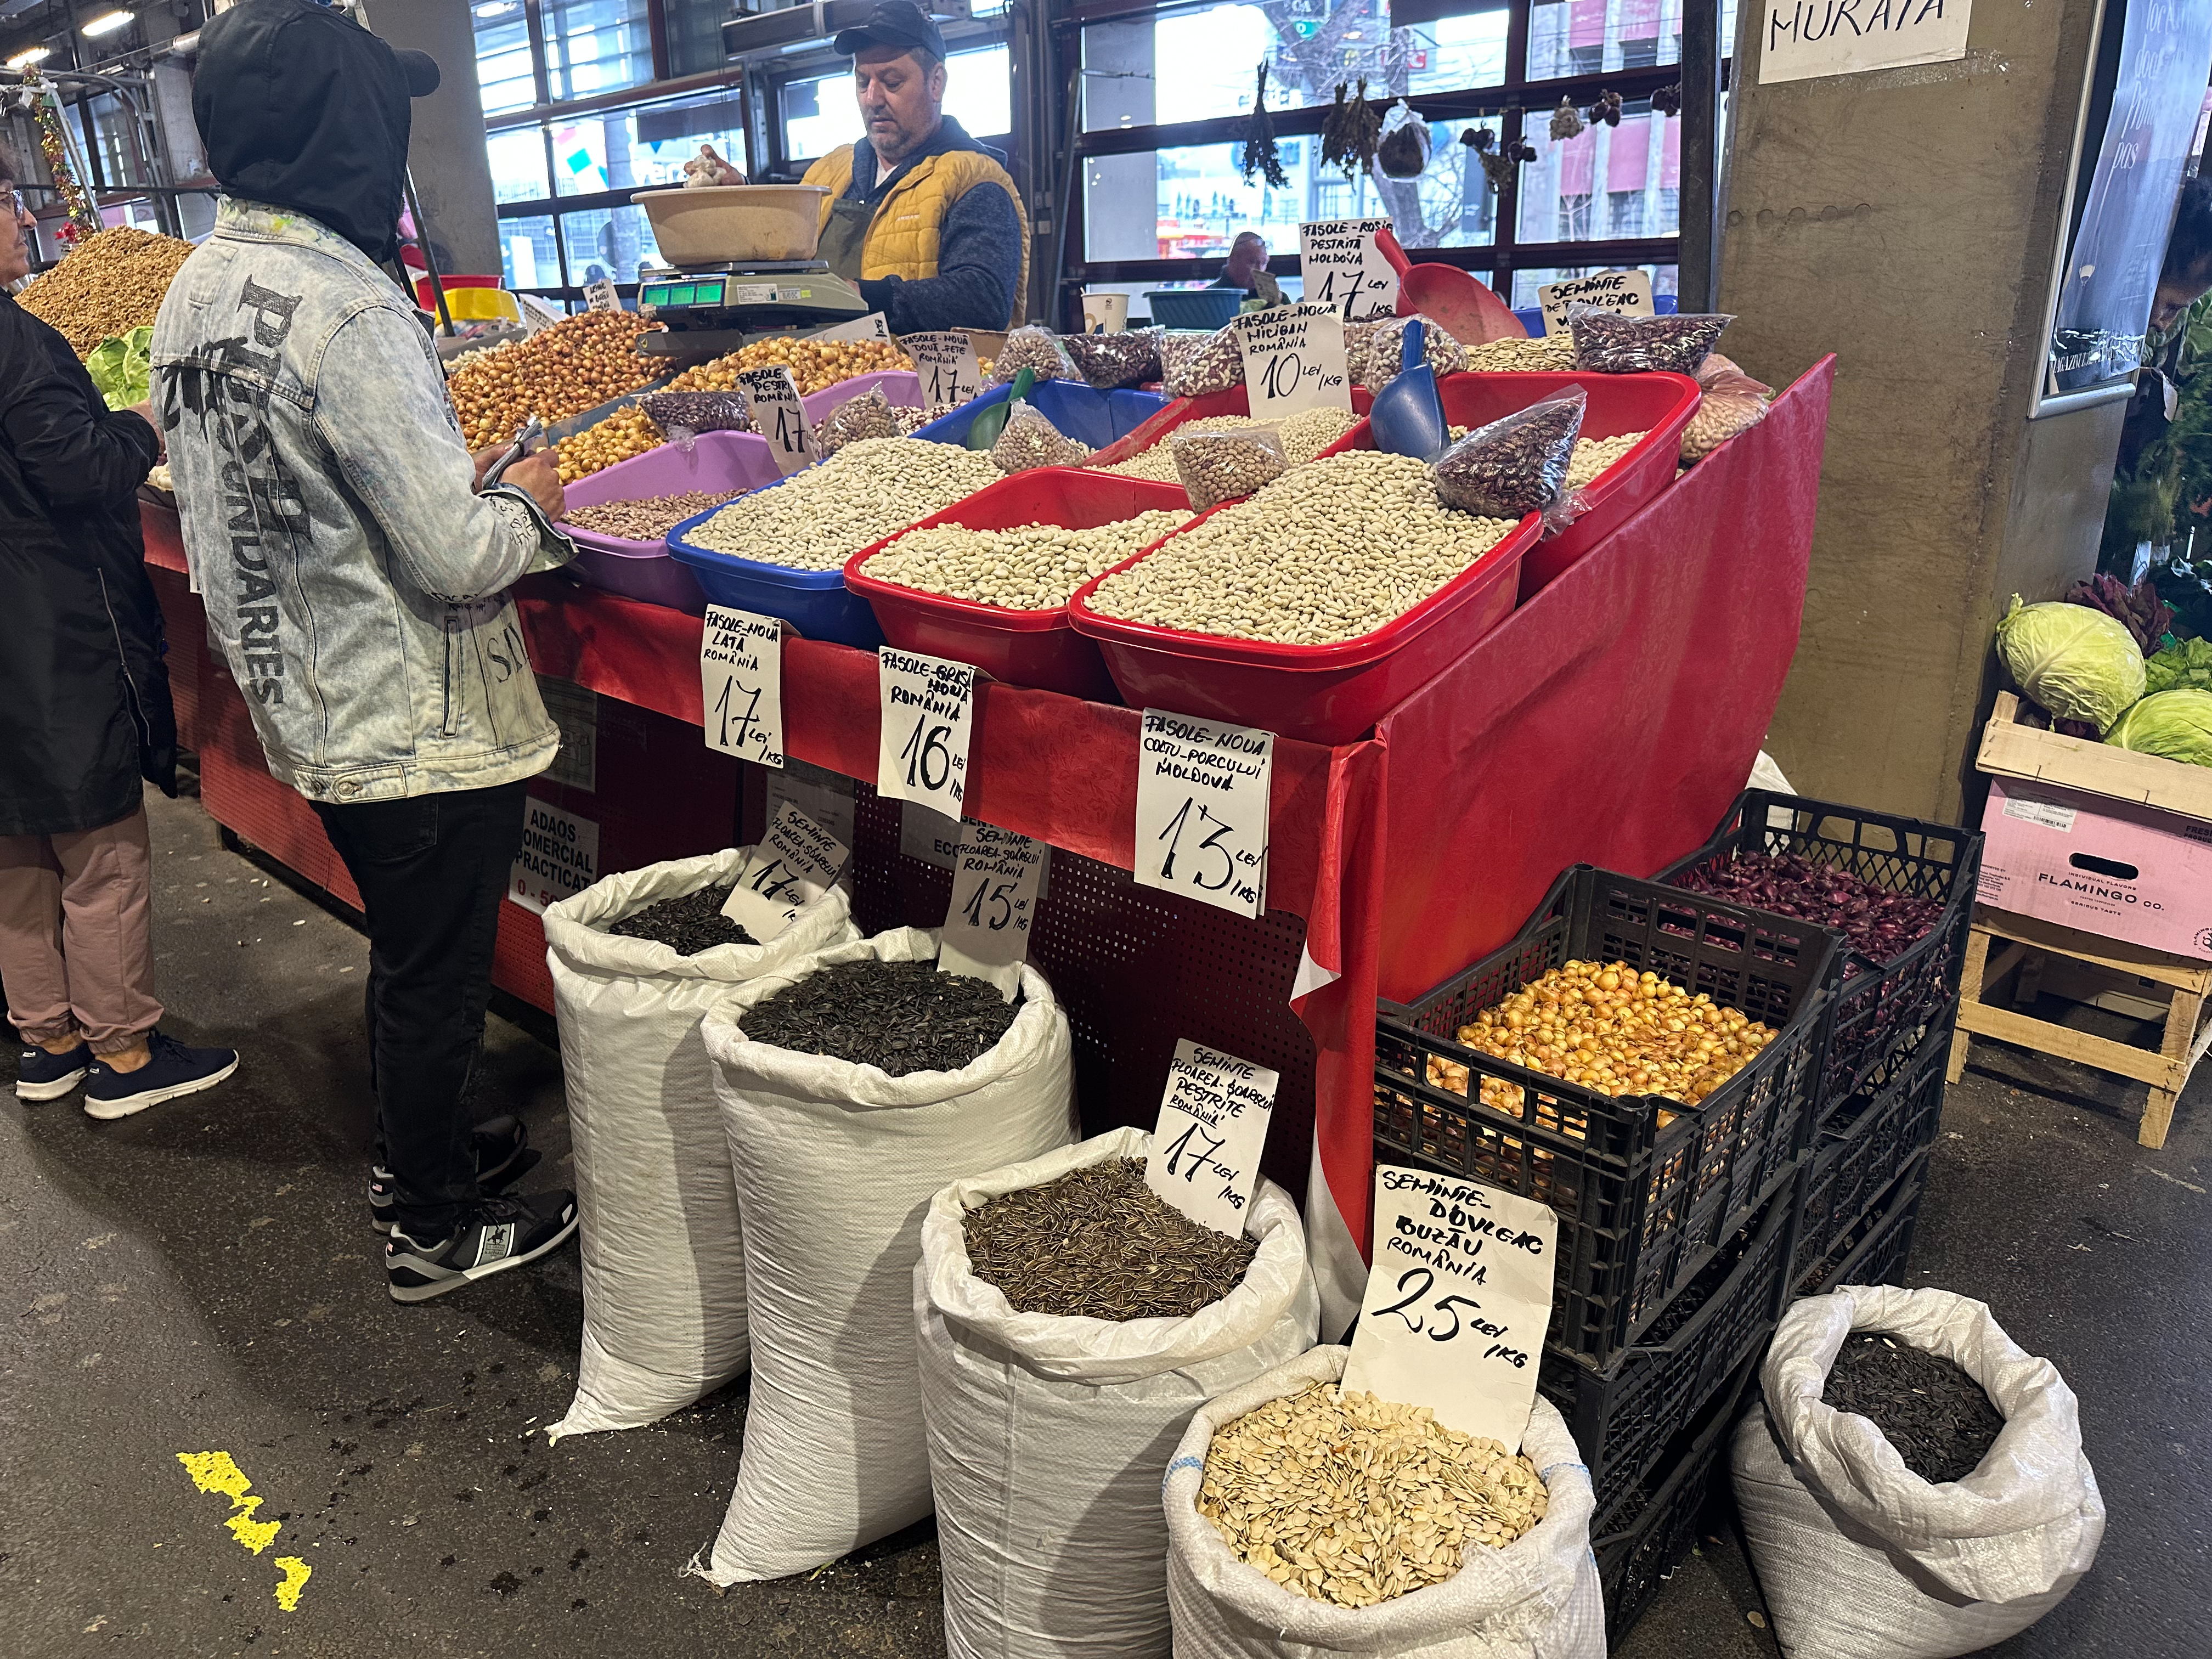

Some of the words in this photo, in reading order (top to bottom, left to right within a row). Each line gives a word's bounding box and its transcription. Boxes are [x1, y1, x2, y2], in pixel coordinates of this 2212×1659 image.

[1318, 270, 1364, 317] 17
[736, 368, 781, 385] FASOLE
[928, 365, 960, 403] 17
[1260, 353, 1301, 399] 10
[776, 407, 805, 453] 17
[704, 647, 758, 671] ROMÂNIA
[714, 675, 762, 747] 17
[891, 686, 960, 721] ROMÂNIA
[901, 714, 952, 790] 16
[530, 809, 576, 843] ADAOS
[1159, 797, 1234, 890] 13
[2186, 825, 2212, 837] FRES
[523, 828, 593, 874] OMERCIAL
[963, 857, 1025, 879] ROMÂNIA
[751, 859, 799, 901] 17
[2038, 872, 2137, 904] FLAMINGO
[2143, 900, 2165, 911] CO.
[782, 909, 795, 922] /K
[962, 878, 1018, 931] 15
[1164, 1122, 1226, 1183] 17
[1430, 1198, 1543, 1255] DOVLEAC
[1387, 1237, 1486, 1285] ROMÂNIA
[1371, 1268, 1481, 1342] 25
